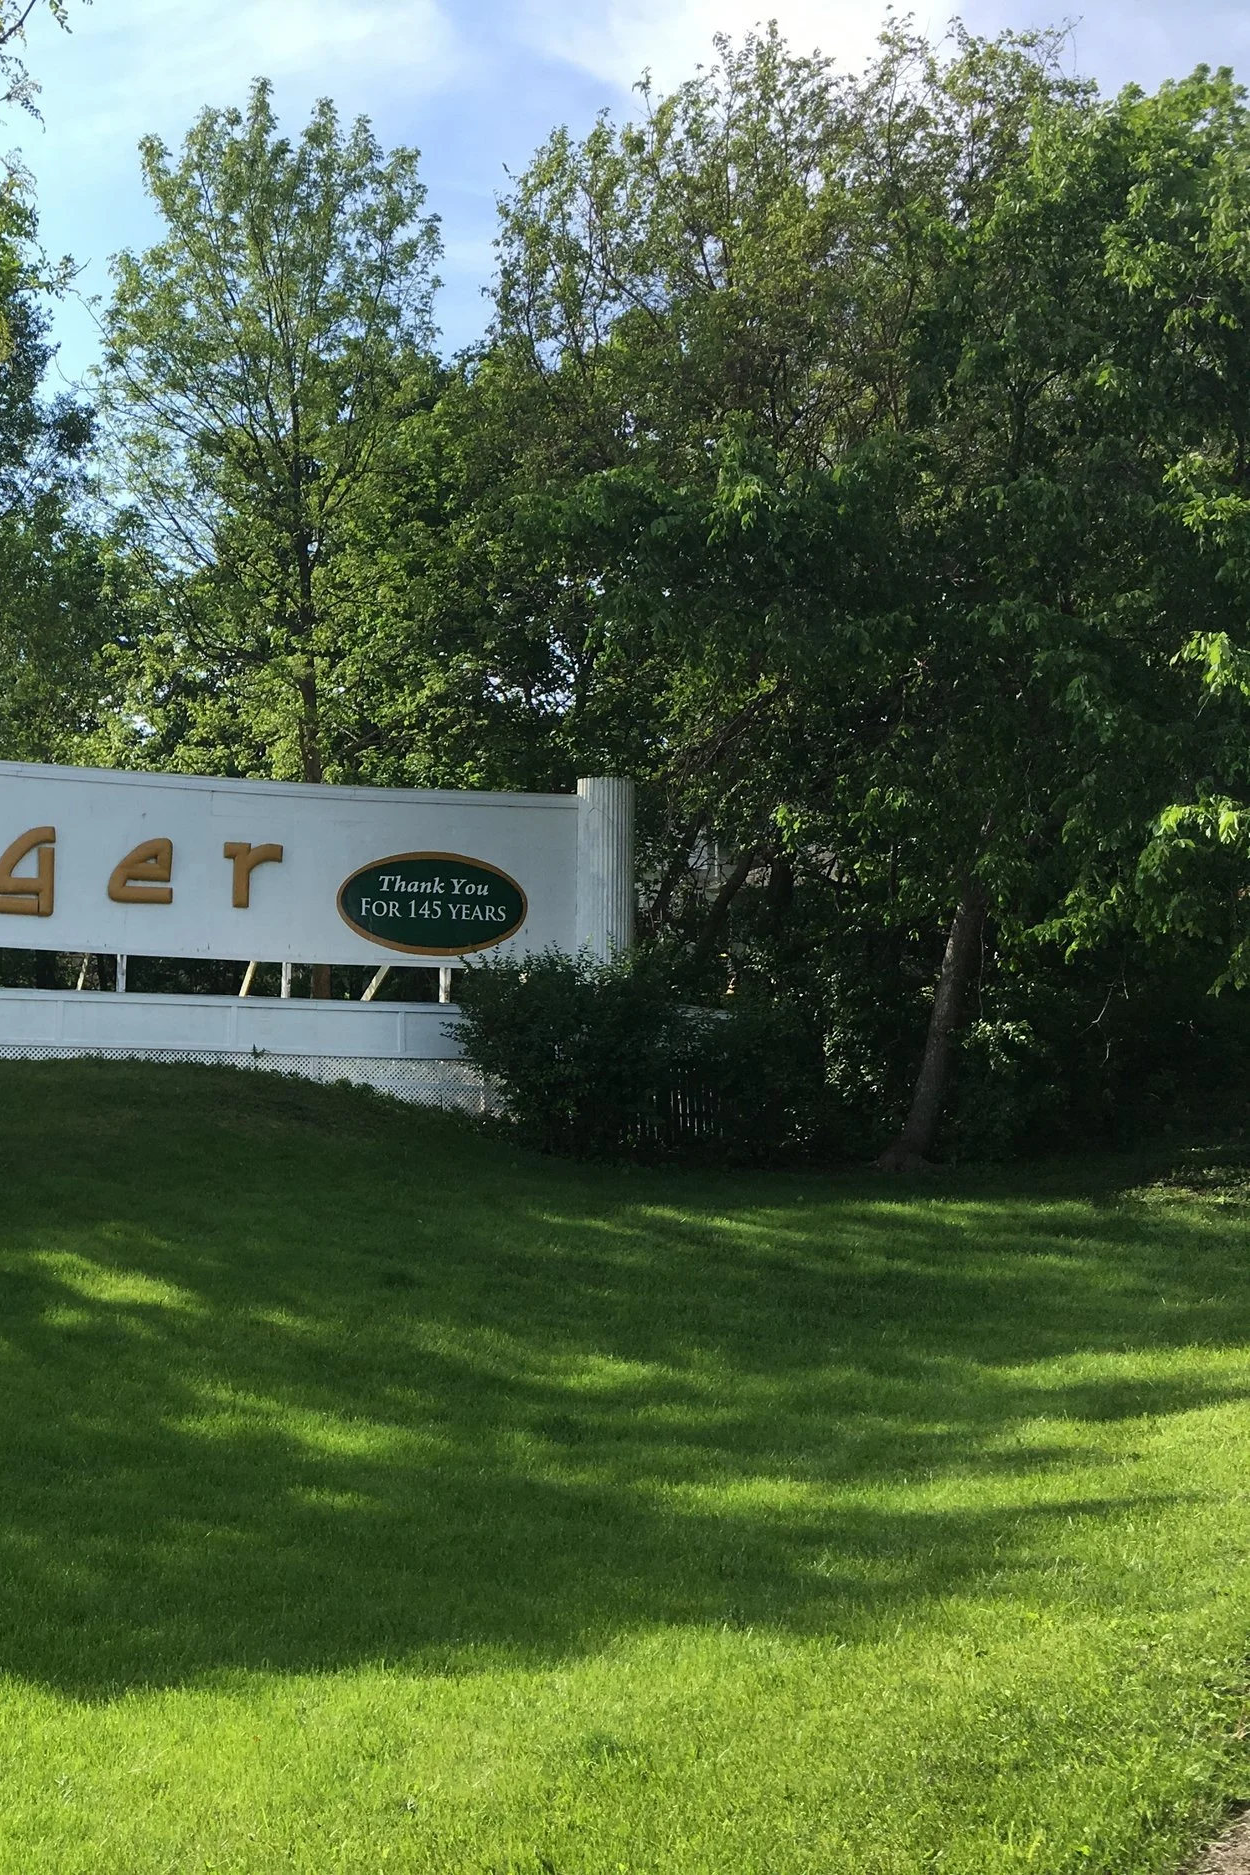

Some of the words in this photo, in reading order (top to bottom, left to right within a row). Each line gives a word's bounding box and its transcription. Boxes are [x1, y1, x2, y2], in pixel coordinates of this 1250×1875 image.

[378, 875, 445, 894] Thank
[450, 878, 489, 896] You
[360, 897, 401, 918] FOR
[408, 900, 442, 919] 145
[448, 903, 507, 922] YEARS
